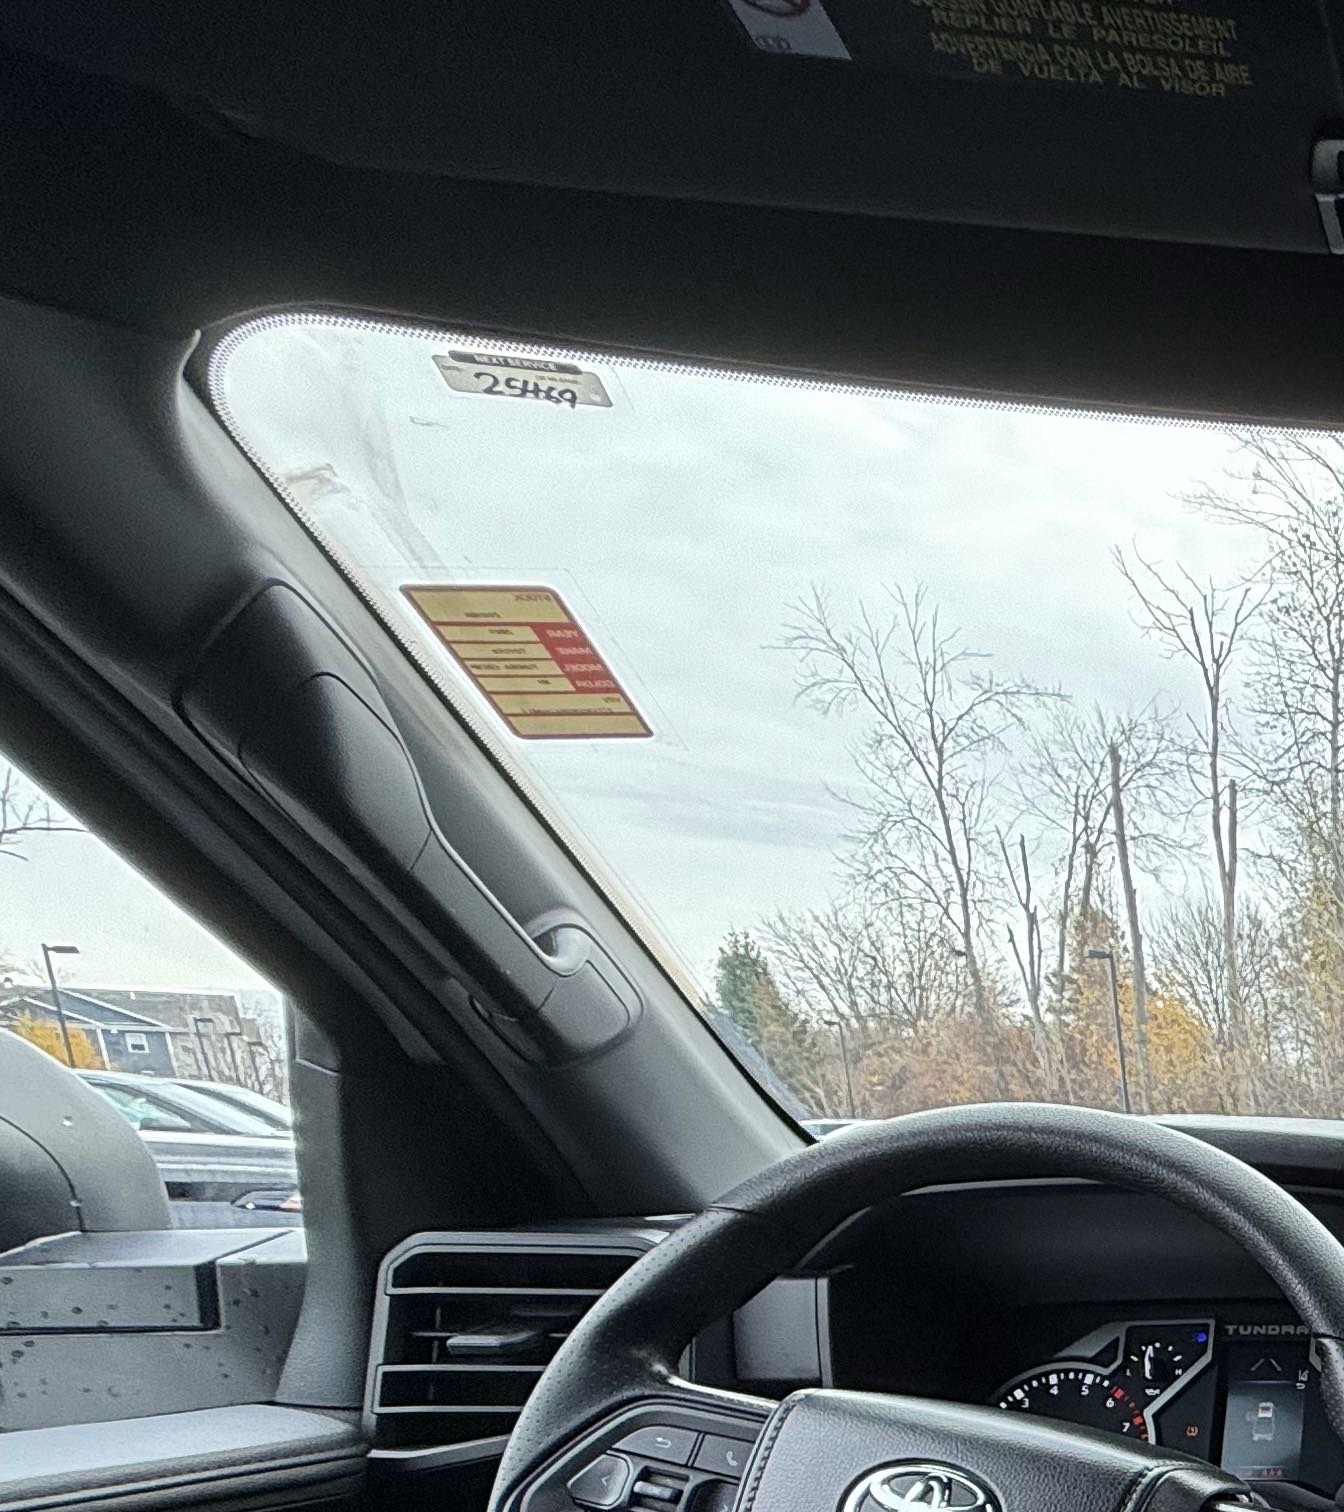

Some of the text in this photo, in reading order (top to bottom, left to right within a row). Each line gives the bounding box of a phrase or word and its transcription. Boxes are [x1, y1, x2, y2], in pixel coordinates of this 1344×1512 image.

[1224, 1324, 1310, 1336] TUNDRA
[1050, 1386, 1059, 1395] 4
[1080, 1386, 1090, 1396] 5
[1021, 1398, 1030, 1408] 3
[1106, 1398, 1115, 1408] 6
[1122, 1422, 1131, 1432] 7
